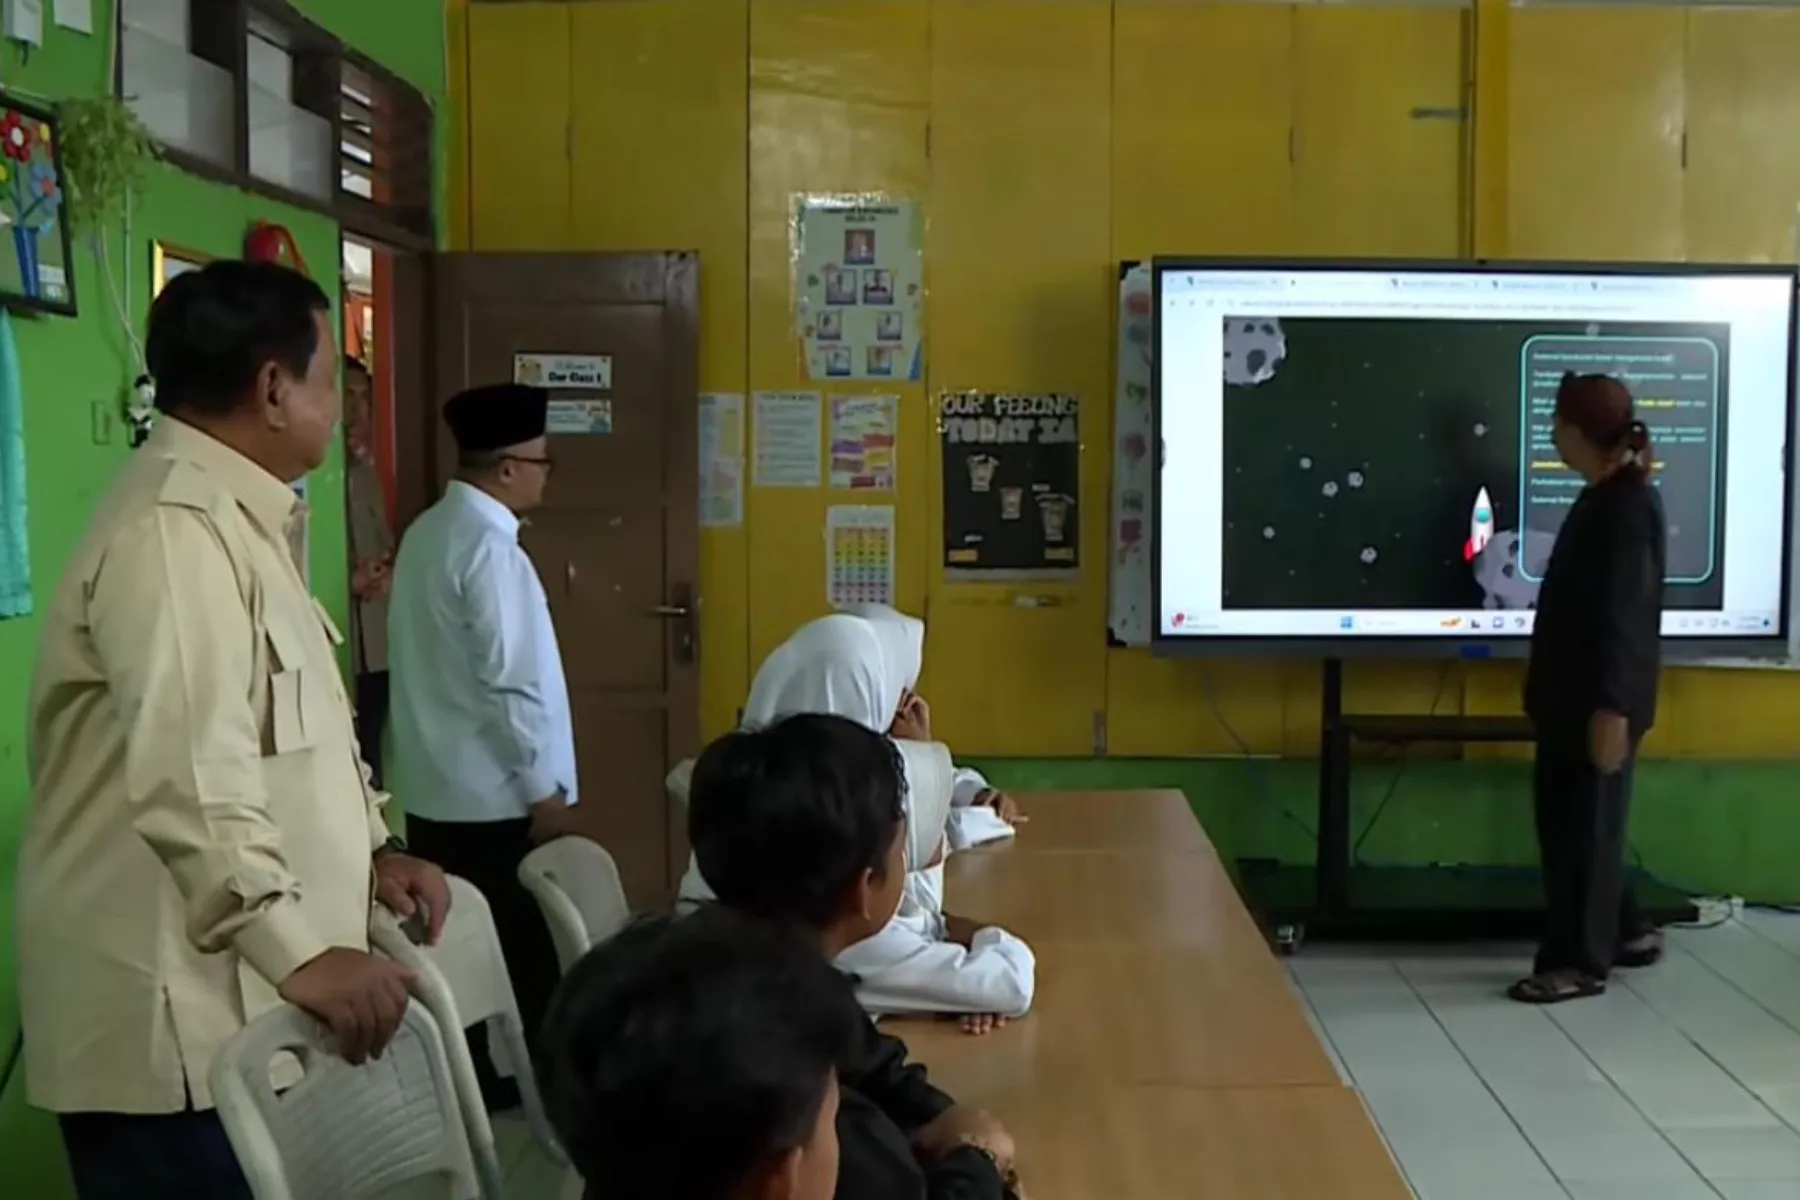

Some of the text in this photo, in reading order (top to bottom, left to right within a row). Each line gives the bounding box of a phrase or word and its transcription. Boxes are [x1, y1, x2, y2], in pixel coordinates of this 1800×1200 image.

[570, 371, 594, 382] Class
[943, 394, 1077, 416] OUR FEELING
[946, 416, 1036, 444] TODAY
